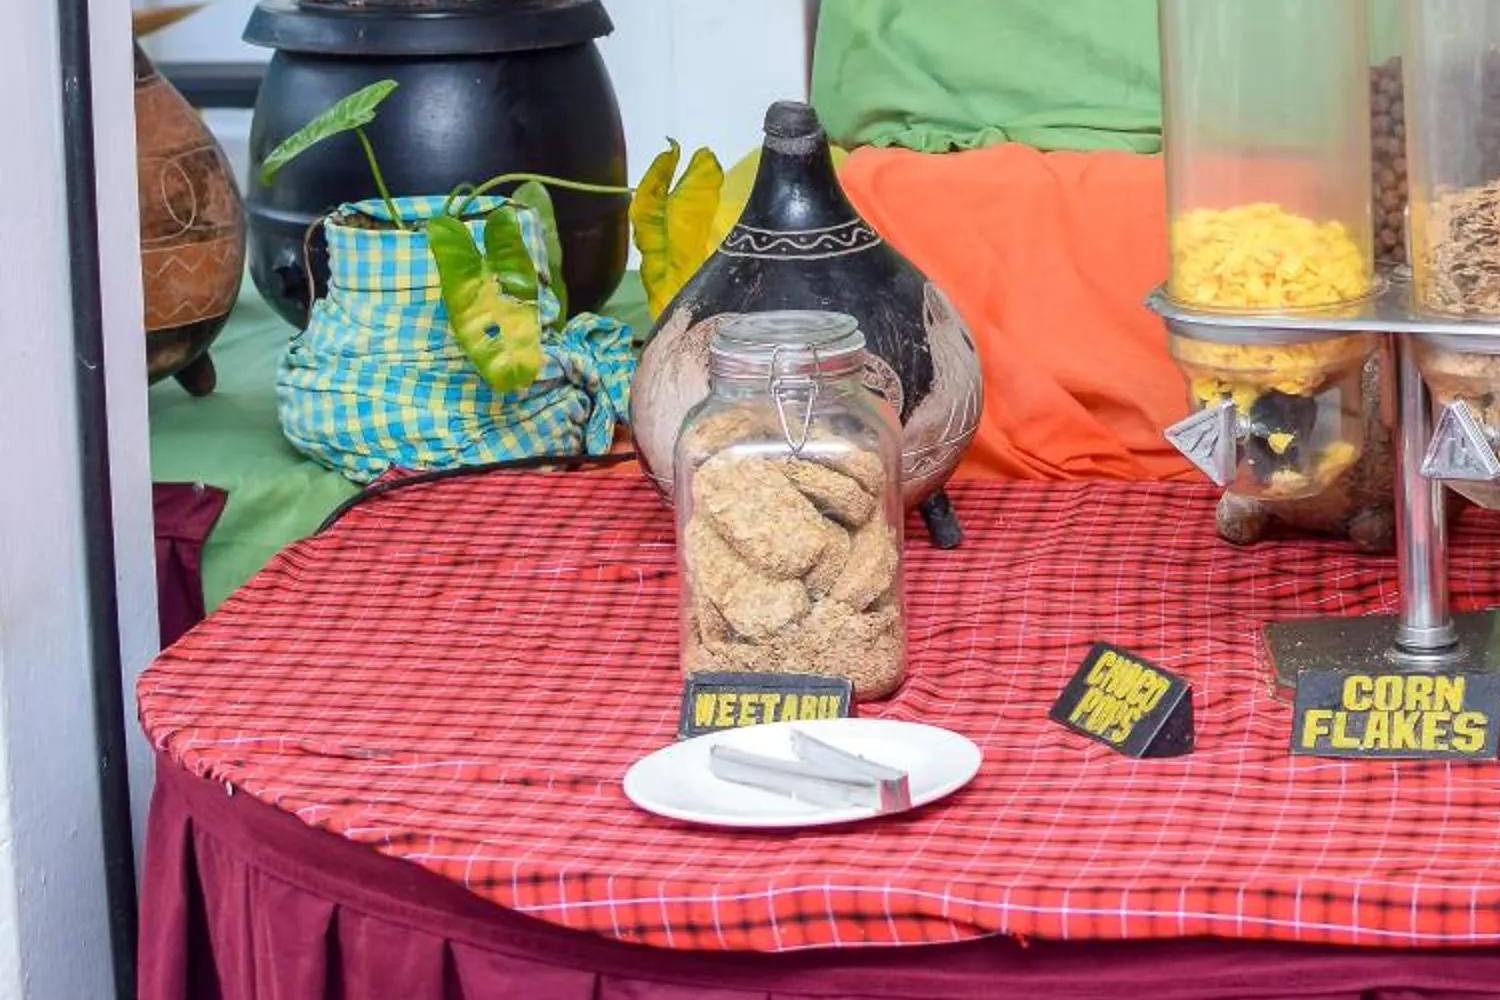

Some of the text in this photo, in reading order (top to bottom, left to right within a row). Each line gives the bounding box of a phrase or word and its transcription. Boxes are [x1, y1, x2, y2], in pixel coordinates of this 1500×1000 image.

[1086, 650, 1170, 713] CHOCO
[1343, 673, 1466, 713] CORN
[1069, 687, 1141, 744] POPS
[1302, 708, 1488, 753] FLAKES
